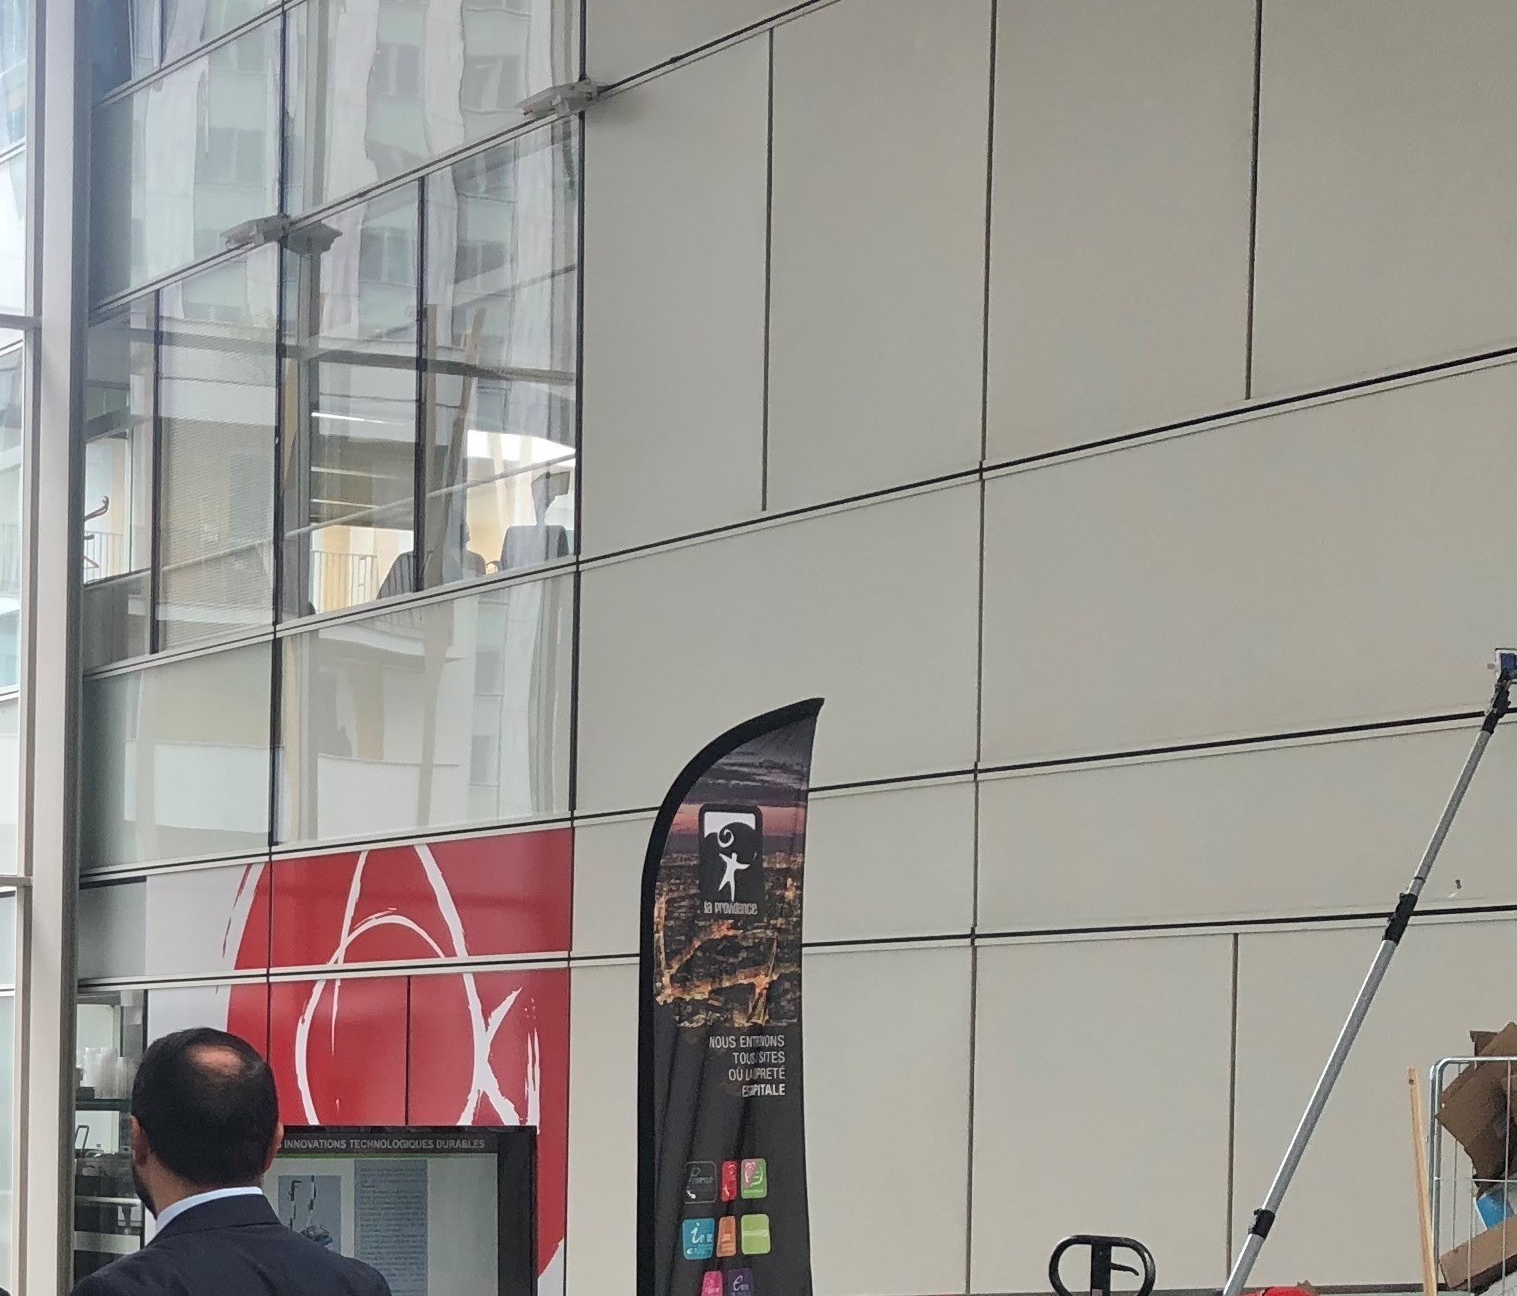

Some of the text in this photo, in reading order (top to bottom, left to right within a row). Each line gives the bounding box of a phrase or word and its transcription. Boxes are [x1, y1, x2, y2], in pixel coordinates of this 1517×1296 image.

[703, 900, 758, 915] la providence
[708, 1035, 737, 1049] NOUS
[283, 1139, 485, 1150] INNOVATIONS TECHNOLOGIQUES DURABLES
